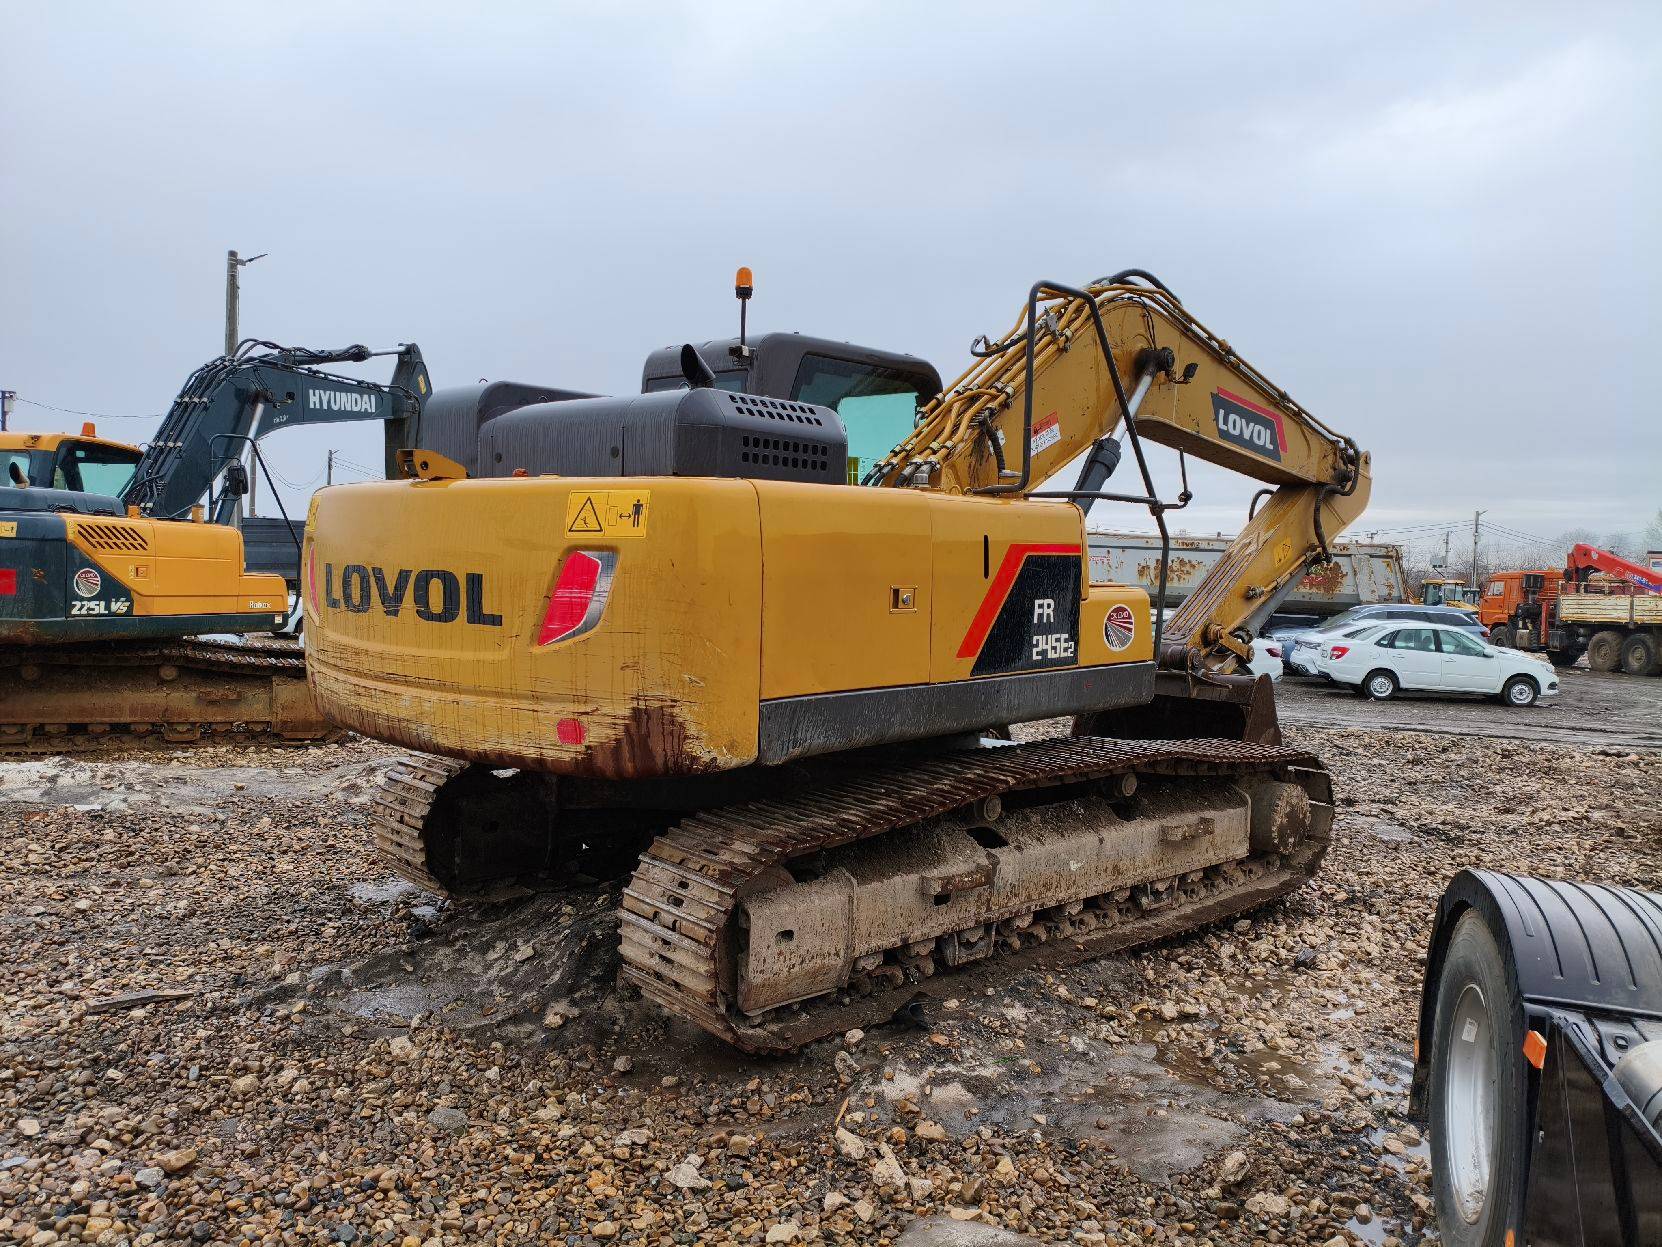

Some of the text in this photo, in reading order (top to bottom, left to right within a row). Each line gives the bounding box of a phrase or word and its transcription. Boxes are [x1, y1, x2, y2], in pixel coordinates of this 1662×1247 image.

[309, 389, 376, 413] HYUNDAI
[1218, 408, 1274, 450] LOVOL
[71, 600, 109, 615] 225L
[325, 562, 503, 627] LOVOL
[1033, 598, 1055, 624] FR
